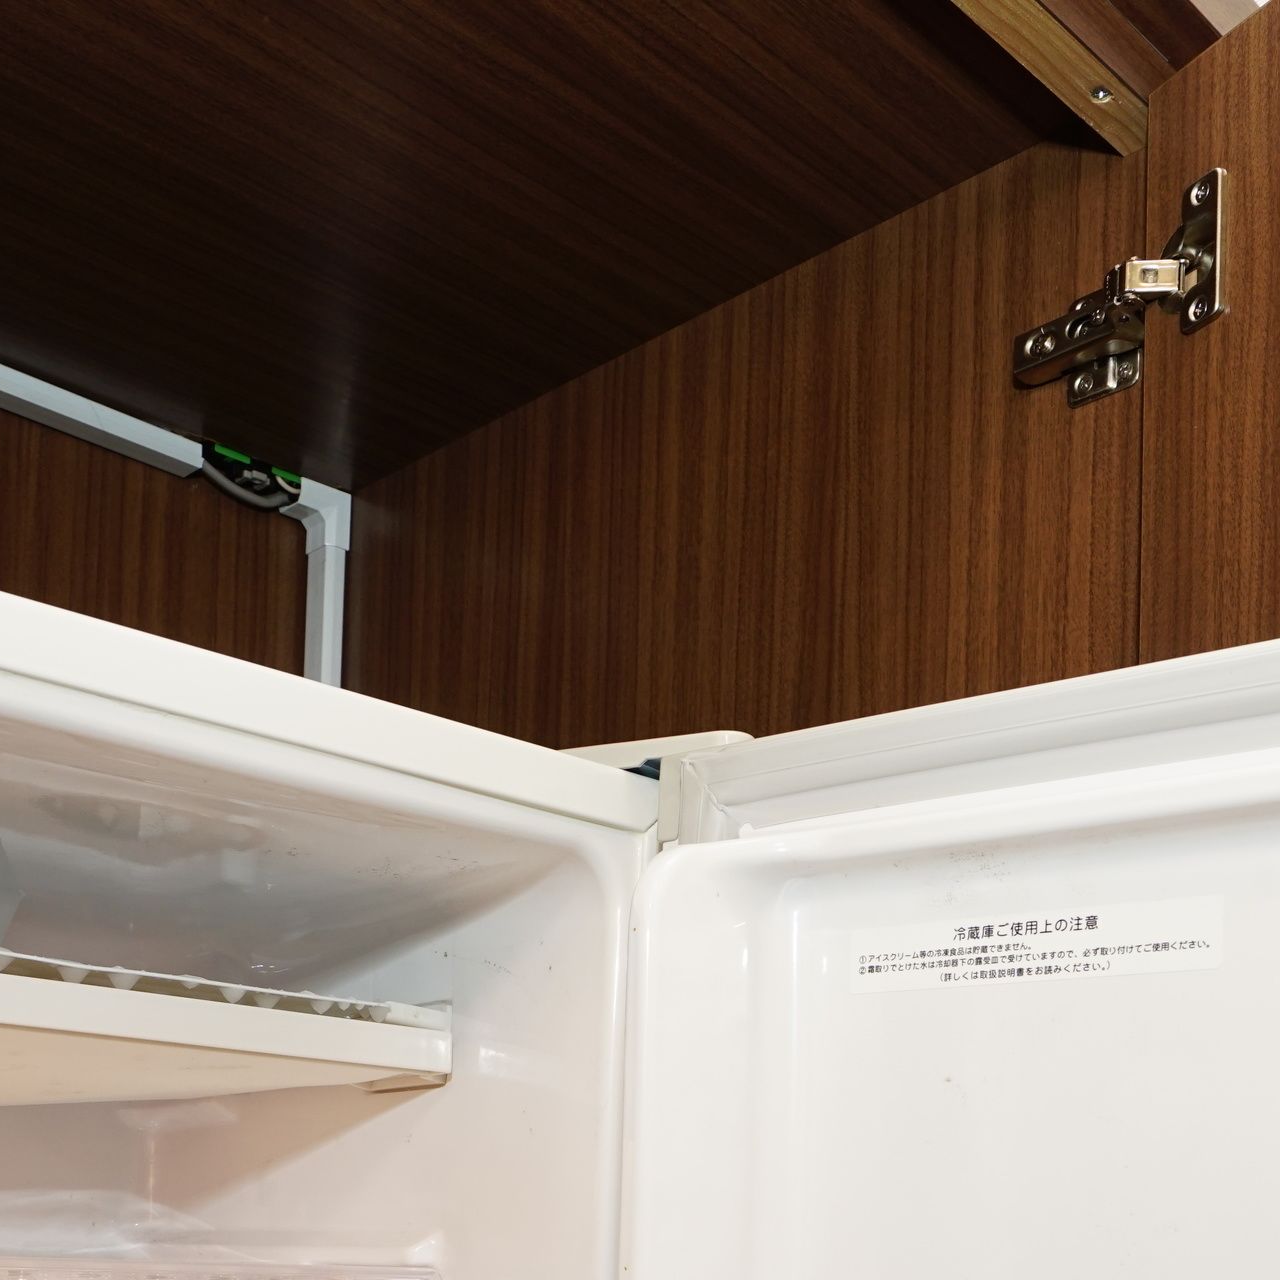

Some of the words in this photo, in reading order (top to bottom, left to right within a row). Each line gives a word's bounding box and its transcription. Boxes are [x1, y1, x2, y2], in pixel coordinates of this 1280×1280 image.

[953, 915, 1099, 941] 冷蔵庫ご使用上の注意
